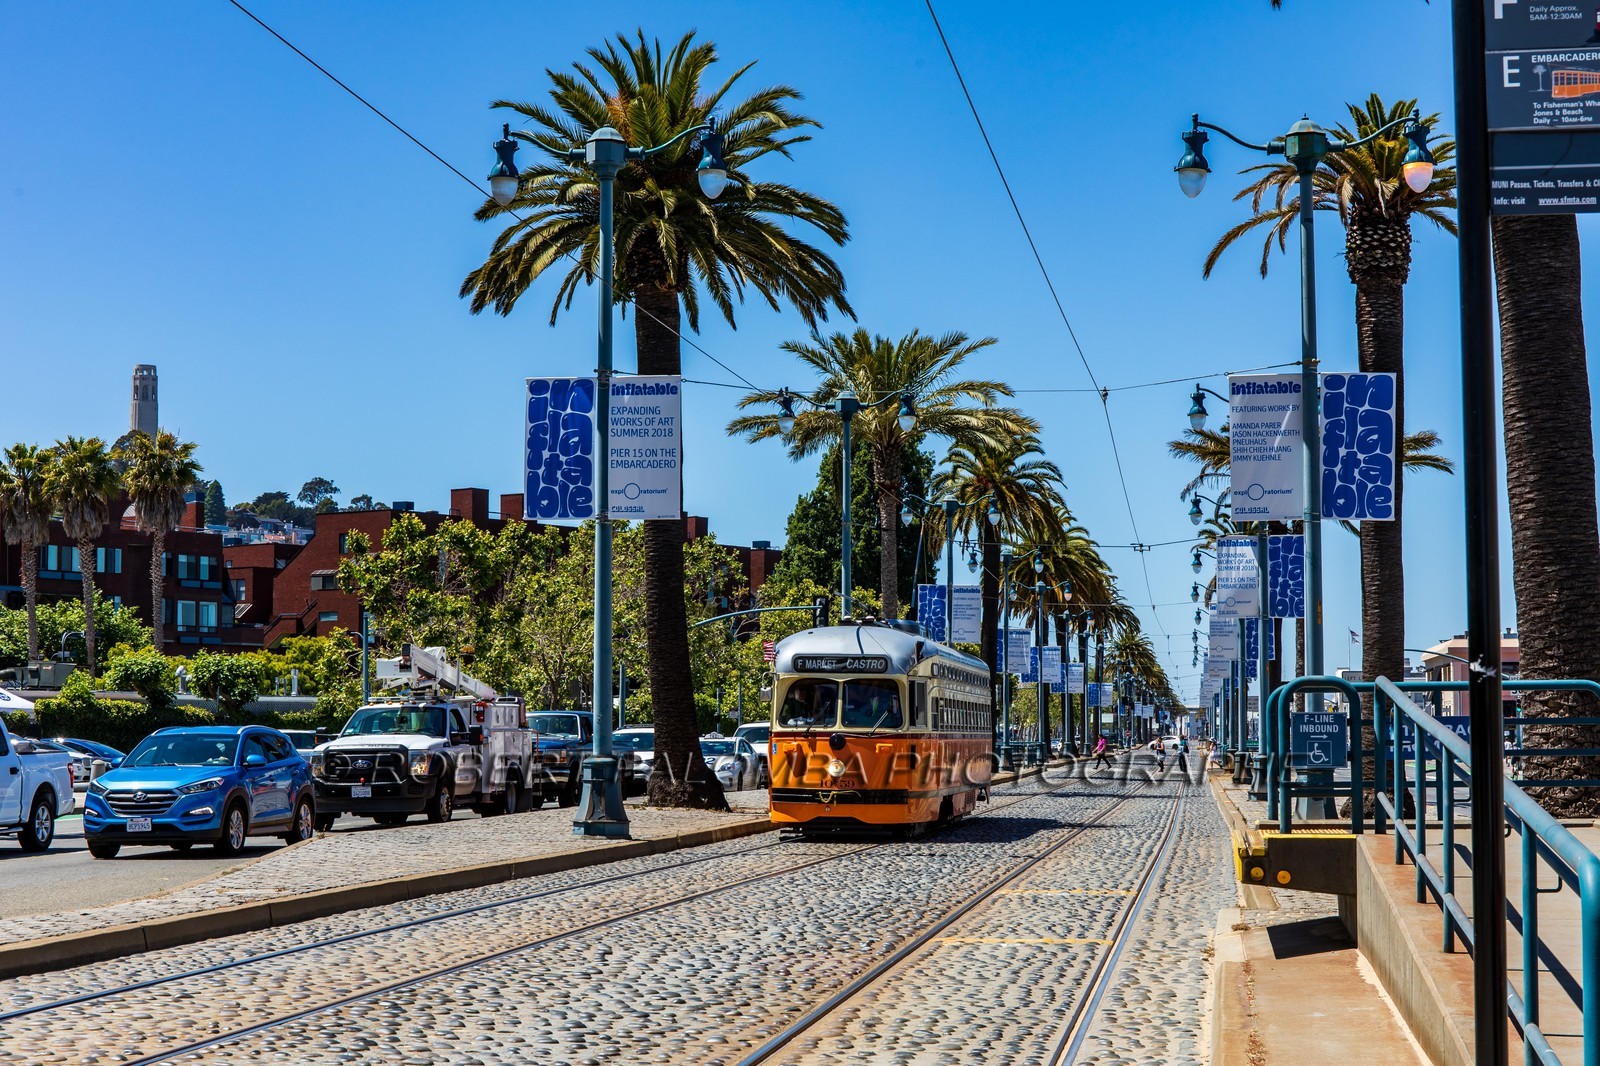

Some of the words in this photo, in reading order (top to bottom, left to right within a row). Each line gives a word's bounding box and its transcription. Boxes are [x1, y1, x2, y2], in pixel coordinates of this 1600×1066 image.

[1529, 13, 1582, 21] 5AM-12:30AM
[1503, 55, 1521, 88] E
[1543, 101, 1584, 109] Fisherman's
[1533, 117, 1551, 125] Daily
[1492, 181, 1509, 189] MUNI
[1510, 180, 1532, 189] Passes,
[1533, 180, 1556, 189] Tickets,
[1557, 180, 1584, 188] Transfers
[1493, 197, 1510, 205] Info:
[1510, 197, 1526, 205] visit
[1538, 195, 1597, 205] www.sfmta.com
[611, 383, 679, 396] inflatable
[1231, 381, 1302, 396] inflatable
[610, 406, 661, 416] EXPANDING
[1231, 405, 1267, 413] FEATURING
[1268, 404, 1291, 412] WORKS
[1291, 404, 1300, 412] BY
[610, 417, 643, 427] WORKS
[644, 417, 656, 426] OF
[657, 416, 675, 426] ART
[1232, 422, 1260, 430] AMANDA
[610, 428, 650, 438] SUMMER
[651, 428, 674, 437] 2018
[1232, 430, 1252, 438] JASON
[1252, 429, 1300, 437] HACKENWERTH
[1232, 438, 1267, 446] PNEUHAUS
[610, 449, 630, 458] PIER
[632, 449, 643, 458] 15
[644, 449, 658, 458] ON
[659, 448, 677, 458] THE
[1232, 454, 1252, 462] JIMMY
[610, 459, 677, 469] EMBARCADERO
[798, 660, 803, 669] F
[846, 659, 885, 669] CASTRO
[1304, 714, 1335, 723] F-LINE
[1300, 724, 1339, 733] INBOUND
